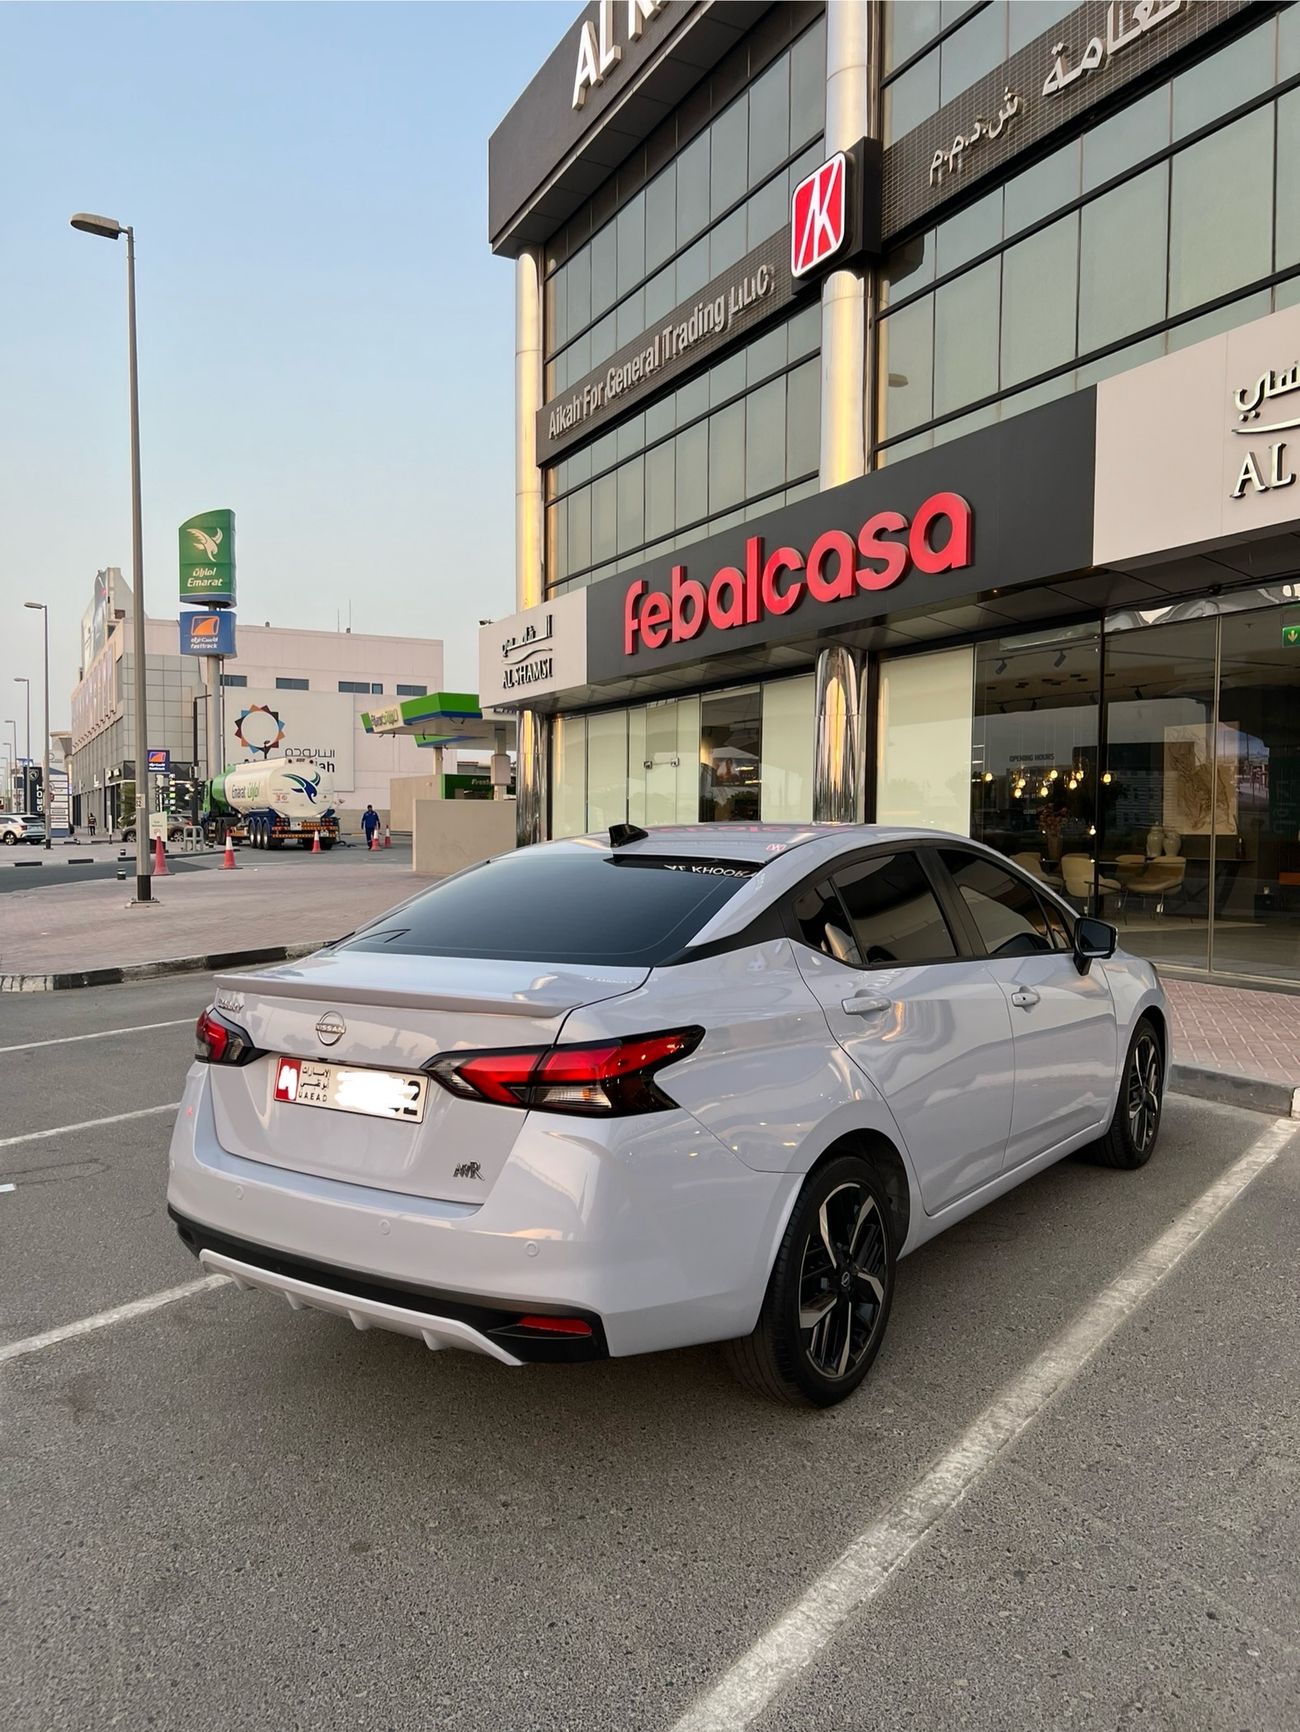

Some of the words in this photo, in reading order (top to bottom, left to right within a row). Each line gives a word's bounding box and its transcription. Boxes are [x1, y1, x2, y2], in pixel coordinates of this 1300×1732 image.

[606, 335, 660, 399] General
[663, 294, 727, 360] Trading
[187, 577, 223, 588] Emarat
[624, 491, 972, 656] febalcasa
[316, 1023, 346, 1034] NISSAN
